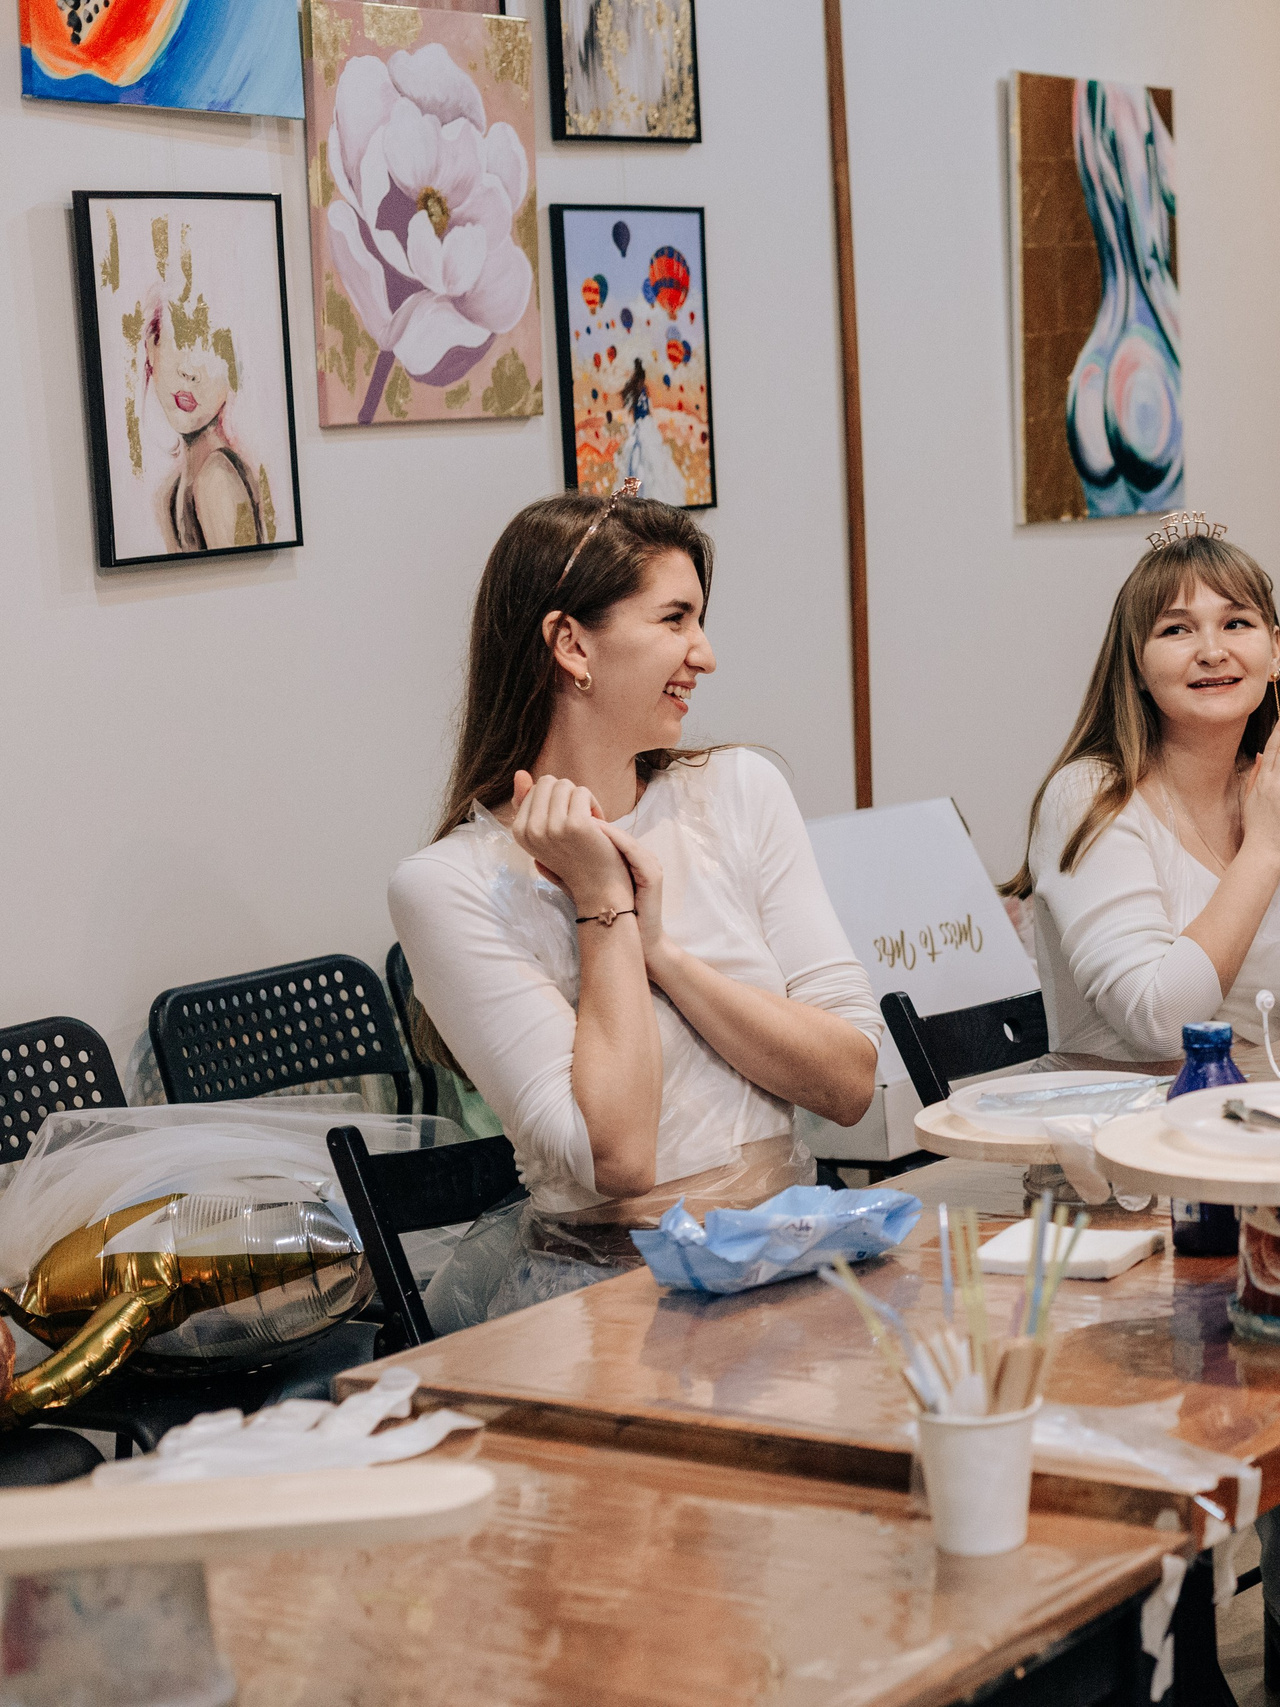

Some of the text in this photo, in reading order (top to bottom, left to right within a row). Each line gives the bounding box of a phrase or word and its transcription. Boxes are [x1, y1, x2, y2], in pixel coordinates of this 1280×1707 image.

[1160, 511, 1206, 526] TEAM
[1146, 521, 1228, 551] BRIDE
[919, 925, 943, 963] to
